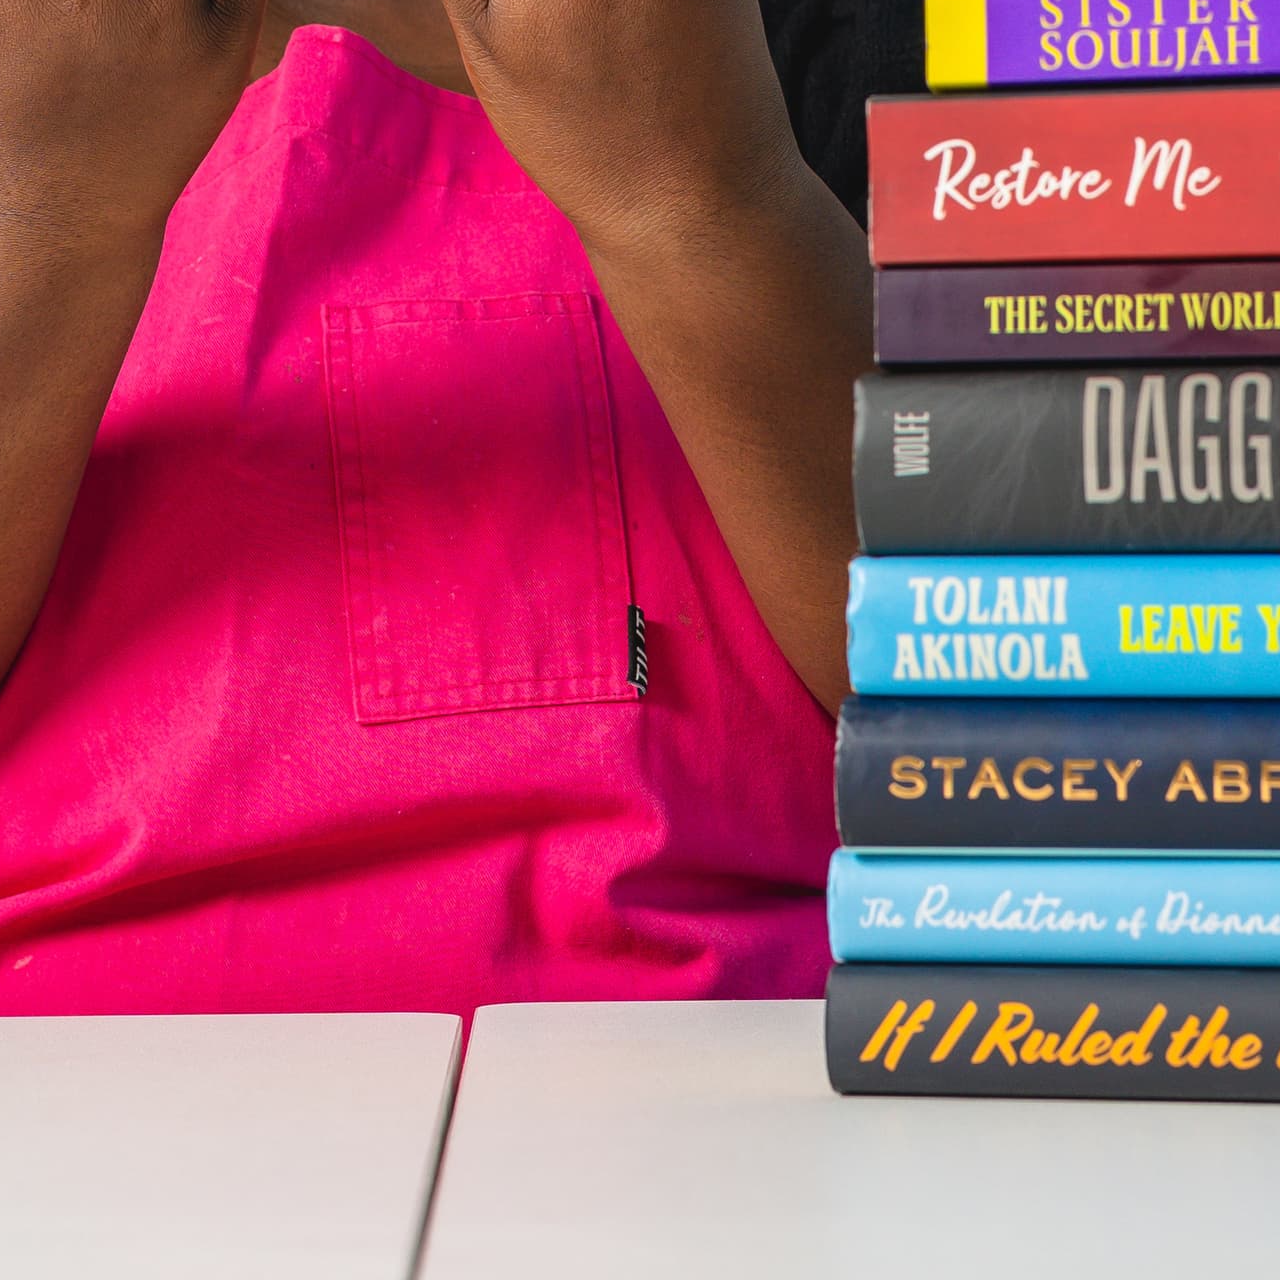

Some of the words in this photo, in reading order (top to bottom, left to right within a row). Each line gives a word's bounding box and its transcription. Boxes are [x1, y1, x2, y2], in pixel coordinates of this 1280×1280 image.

[1038, 24, 1261, 73] SOULJAH
[924, 138, 1112, 221] Restore
[1124, 136, 1221, 211] Me
[985, 296, 1050, 335] THE
[1056, 293, 1175, 334] SECRET
[894, 412, 931, 477] WOLFE
[909, 576, 1067, 627] TOLANI
[1119, 604, 1242, 654] LEAVE
[893, 631, 1089, 682] AKINOLA
[888, 755, 1143, 804] STACEY
[860, 894, 905, 931] The
[917, 883, 1108, 936] Revelation
[1115, 903, 1148, 940] of
[860, 1000, 935, 1071] If
[942, 1001, 978, 1061] I
[972, 1002, 1164, 1067] Ruled
[1166, 1005, 1261, 1069] the
